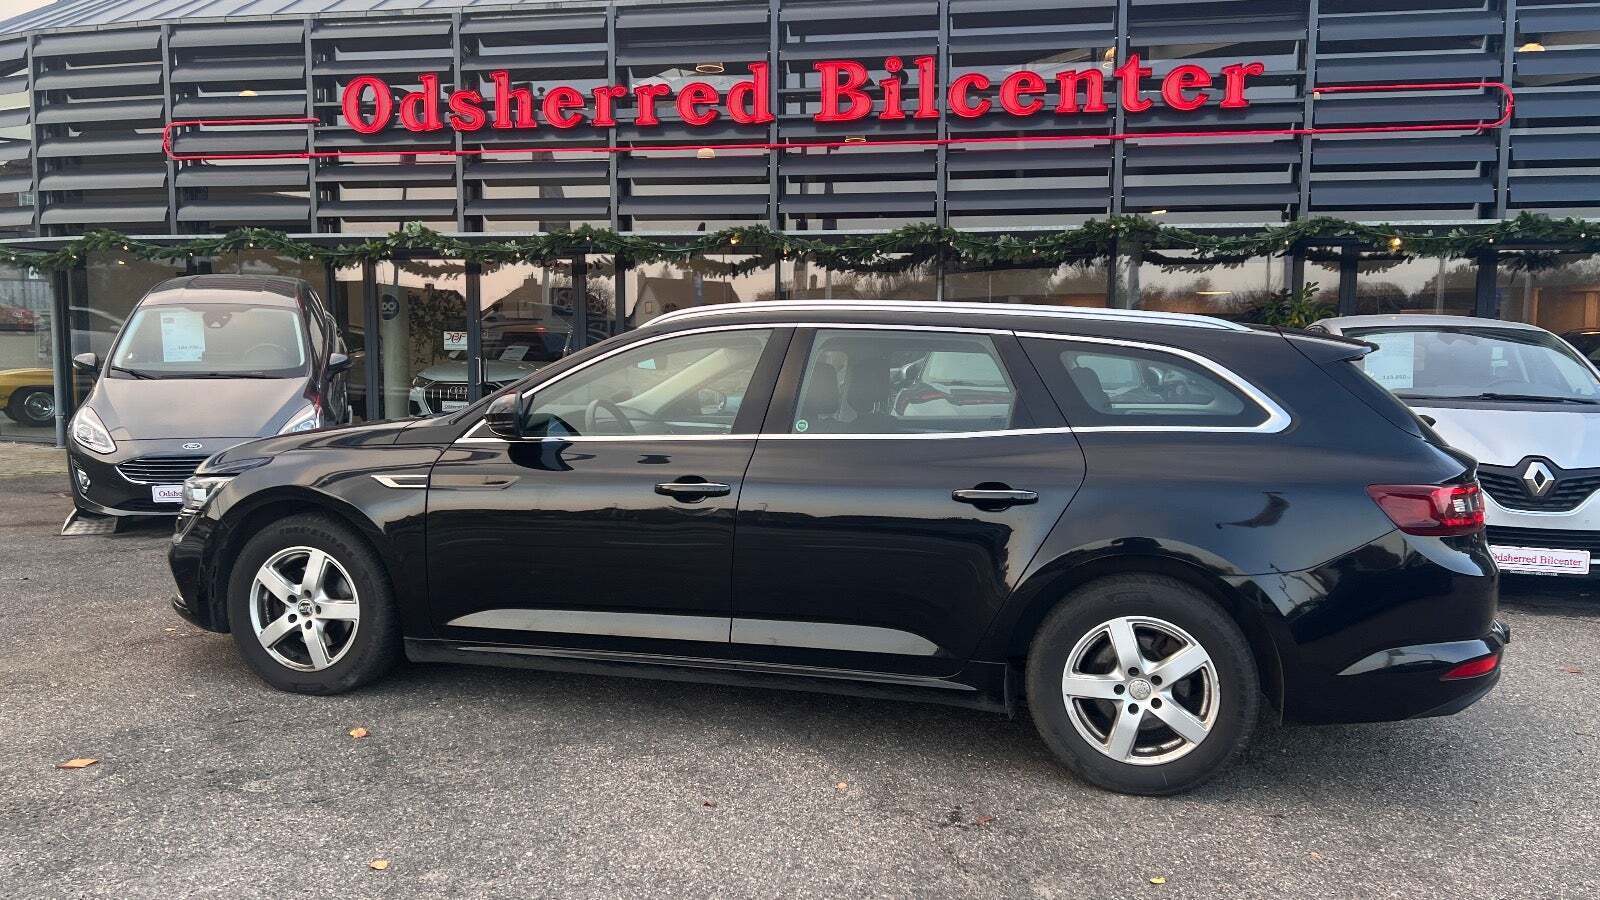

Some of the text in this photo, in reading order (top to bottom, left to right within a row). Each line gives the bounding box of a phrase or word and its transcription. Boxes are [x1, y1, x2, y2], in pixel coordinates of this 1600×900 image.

[341, 54, 1264, 134] Odsherred Bilcenter
[1541, 555, 1581, 566] Bilcenter
